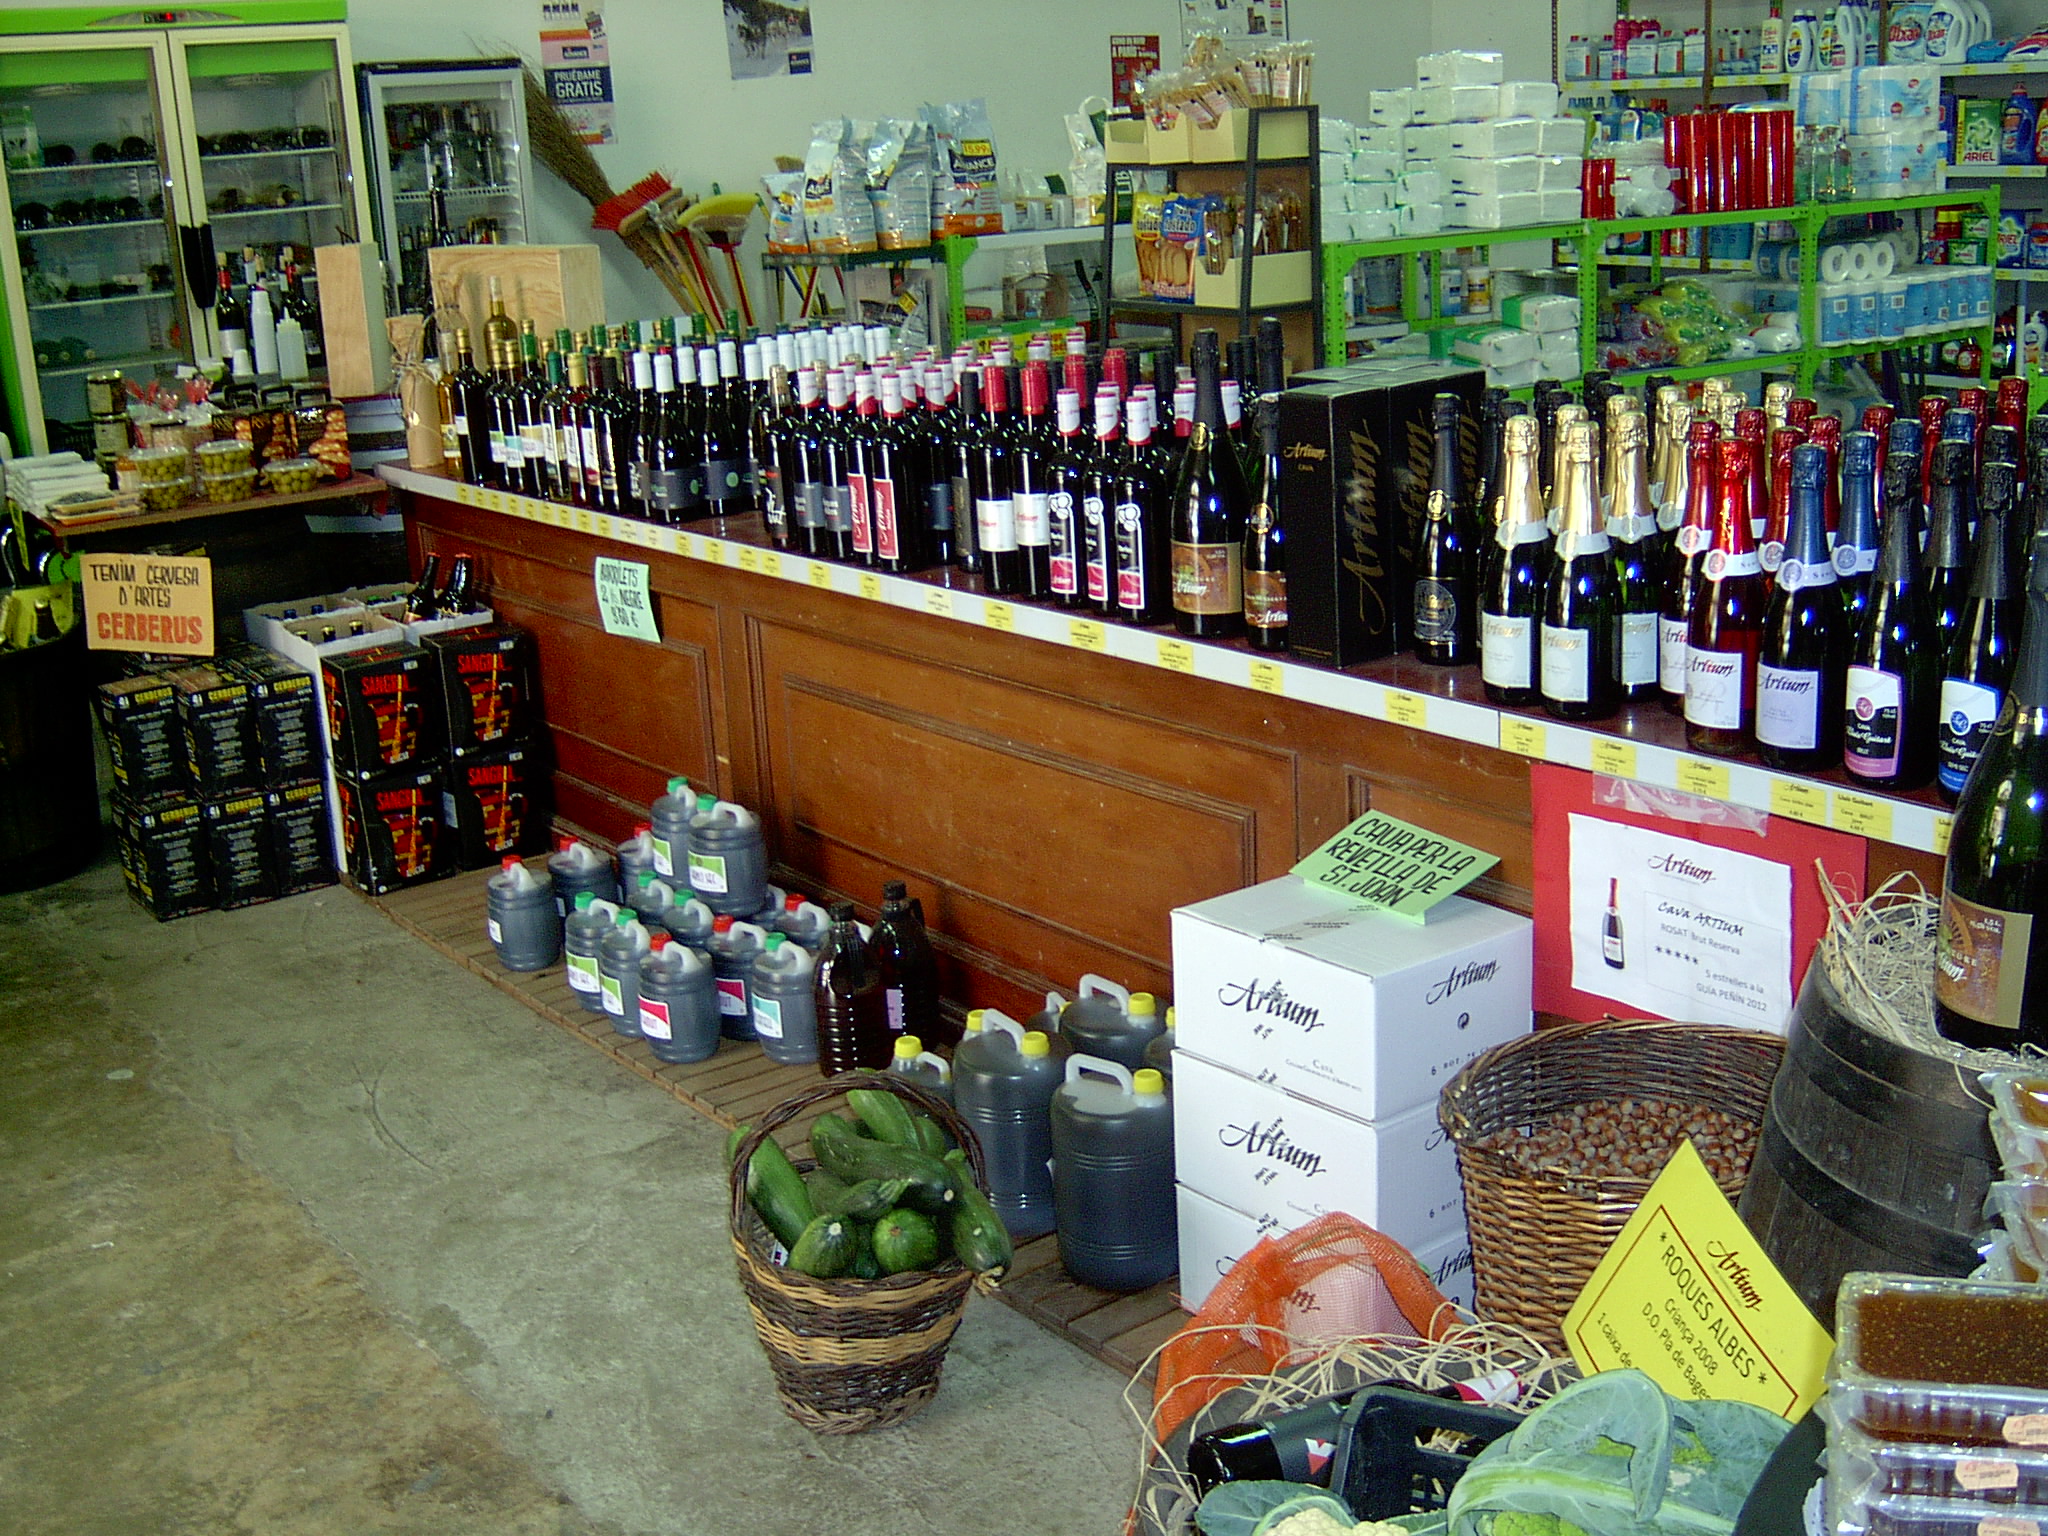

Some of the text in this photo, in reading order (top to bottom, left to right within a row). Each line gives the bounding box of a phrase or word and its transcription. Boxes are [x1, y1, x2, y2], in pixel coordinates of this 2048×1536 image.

[555, 81, 603, 98] GRATIS
[1963, 151, 1996, 162] ARIEL
[1998, 233, 2018, 245] RIEL
[146, 565, 199, 586] CERVESA
[97, 612, 203, 644] CERBERUS
[1685, 655, 1736, 678] Artium
[1759, 672, 1814, 695] Artium
[1353, 818, 1476, 876] CAVA PER LA
[1412, 871, 1452, 894] DE
[1647, 853, 1717, 884] Artium
[1320, 864, 1414, 907] ST. JOAN
[1658, 901, 1744, 936] Cava ARTIUM
[1660, 923, 1740, 955] ROSAT Brut Reserva
[1425, 959, 1500, 1005] Artium
[1705, 969, 1711, 979] 5
[1712, 972, 1748, 990] estrelles
[1757, 984, 1764, 995] la
[1218, 978, 1325, 1033] Artium
[1746, 996, 1767, 1012] 2012
[1431, 1065, 1437, 1076] 6
[1219, 1119, 1327, 1178] Artium
[1429, 1208, 1435, 1219] 6
[1706, 1240, 1764, 1312] Artium
[1660, 1244, 1756, 1378] ROQUES ALBES
[1601, 1322, 1621, 1355] caixa
[1621, 1352, 1632, 1368] de
[1641, 1301, 1661, 1334] D.O.
[1659, 1328, 1674, 1352] Pla
[1672, 1349, 1685, 1369] de
[1664, 1297, 1719, 1376] Criança 2008
